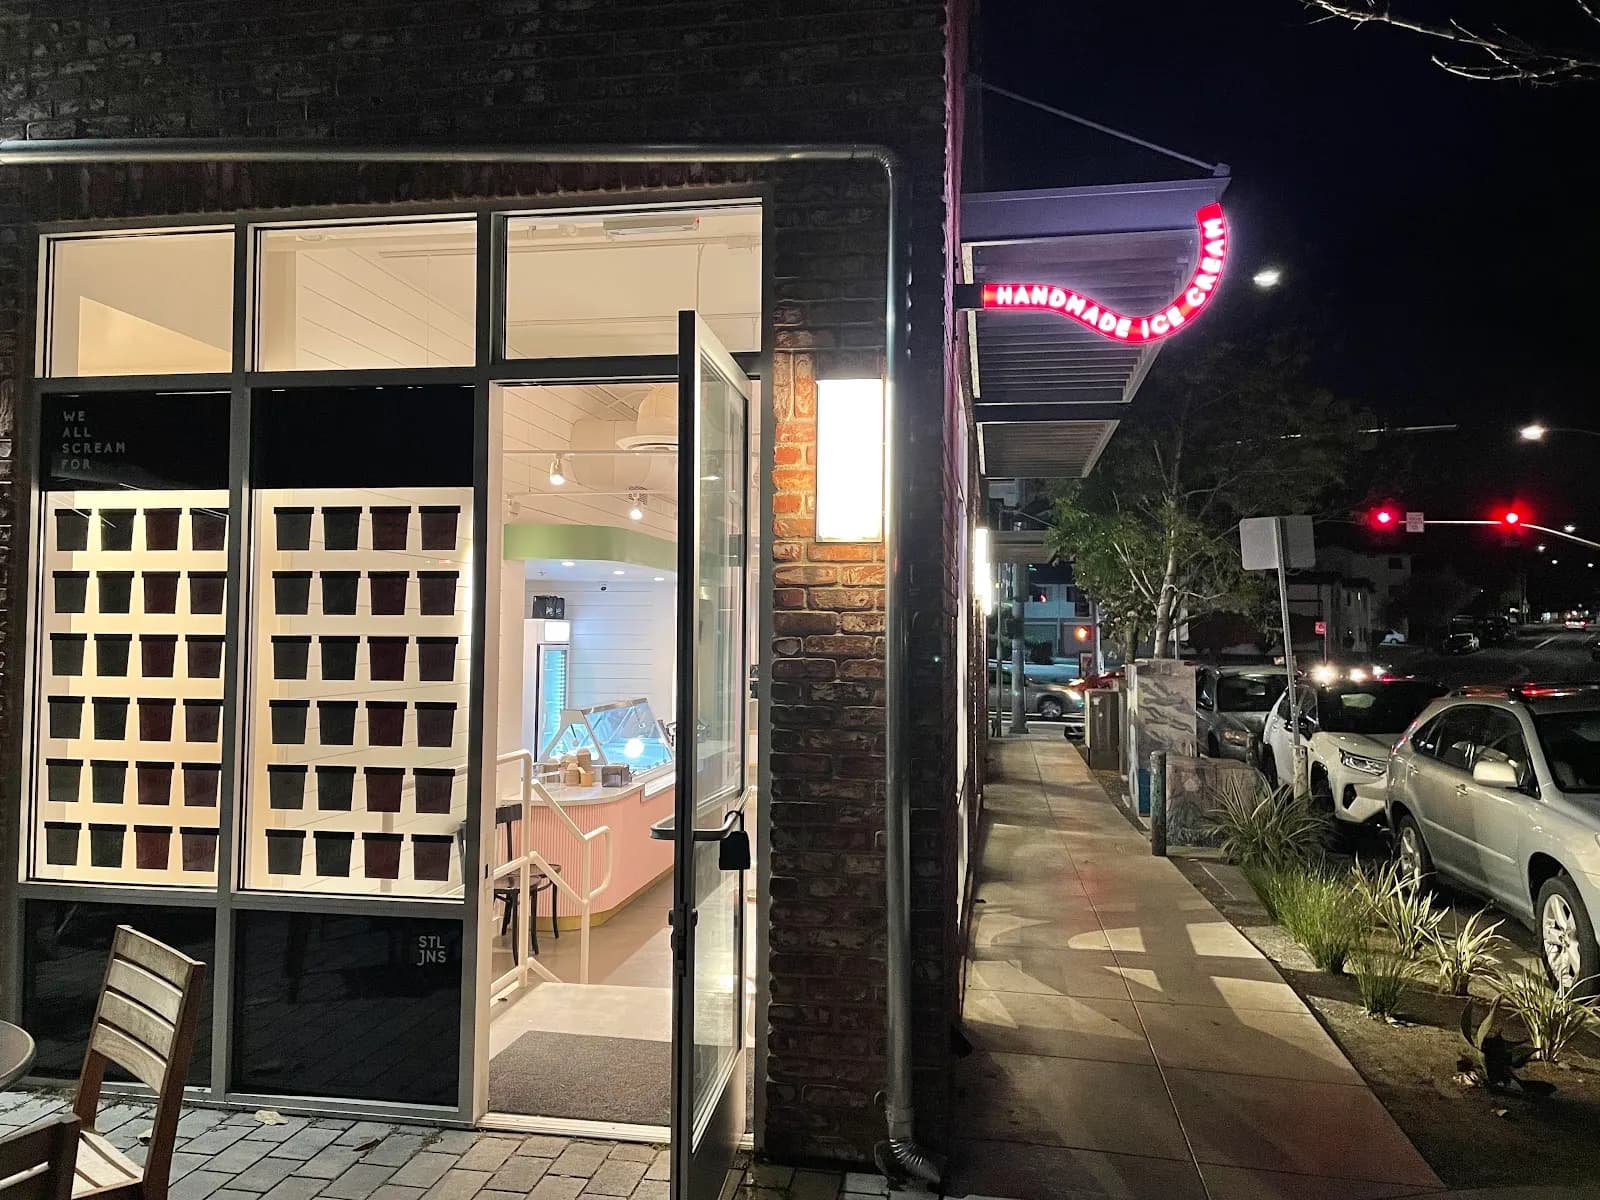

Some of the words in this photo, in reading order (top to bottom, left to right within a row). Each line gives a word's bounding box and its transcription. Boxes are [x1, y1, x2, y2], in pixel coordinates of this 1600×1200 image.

[996, 286, 1131, 338] HANDMADE
[1140, 306, 1185, 339] ICE
[1185, 217, 1225, 307] CREAM
[63, 411, 86, 422] WE
[62, 427, 92, 438] ALL
[62, 442, 126, 454] SCREAM
[61, 459, 91, 470] FOR
[418, 935, 446, 948] STL
[416, 949, 447, 966] JNS
